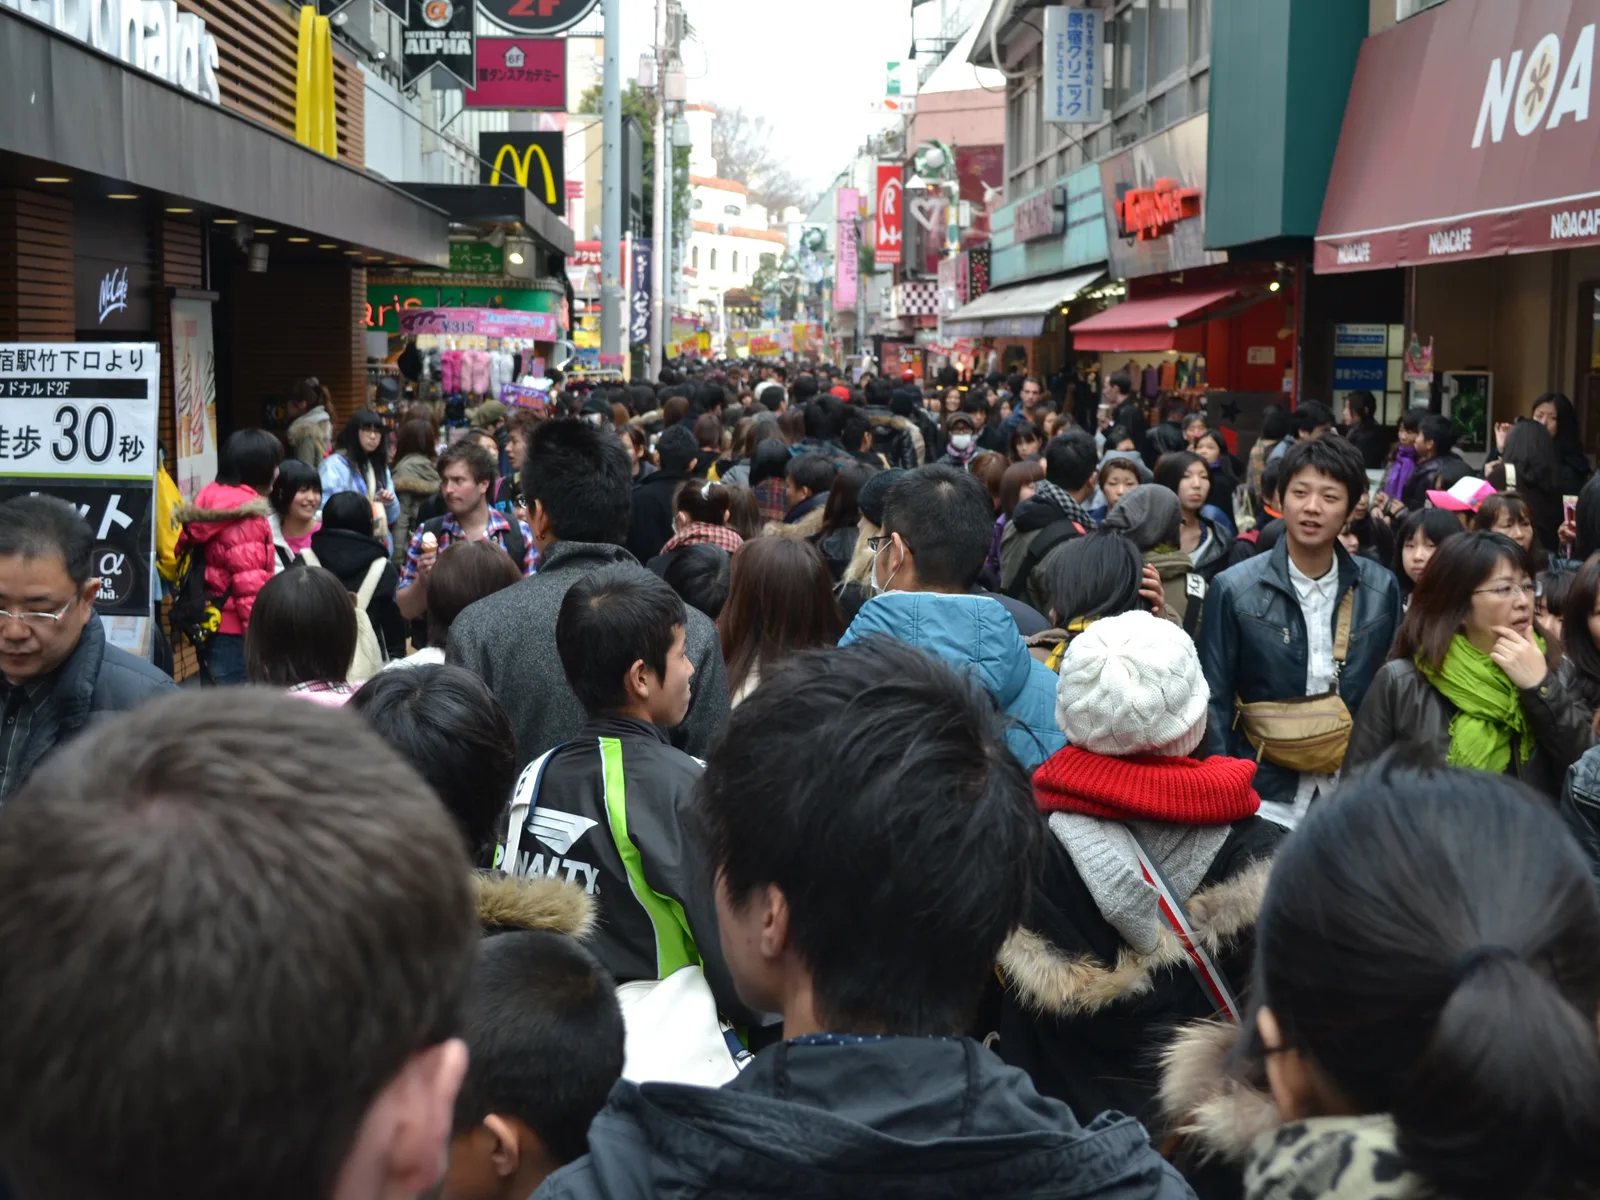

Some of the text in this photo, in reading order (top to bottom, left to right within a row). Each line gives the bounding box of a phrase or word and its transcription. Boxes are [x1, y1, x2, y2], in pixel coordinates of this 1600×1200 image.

[404, 39, 472, 55] ALPHA
[1471, 23, 1596, 149] NOA
[1429, 228, 1471, 255] NOACAFE
[0, 349, 144, 371] 宿駅竹下口より
[52, 405, 115, 463] 30
